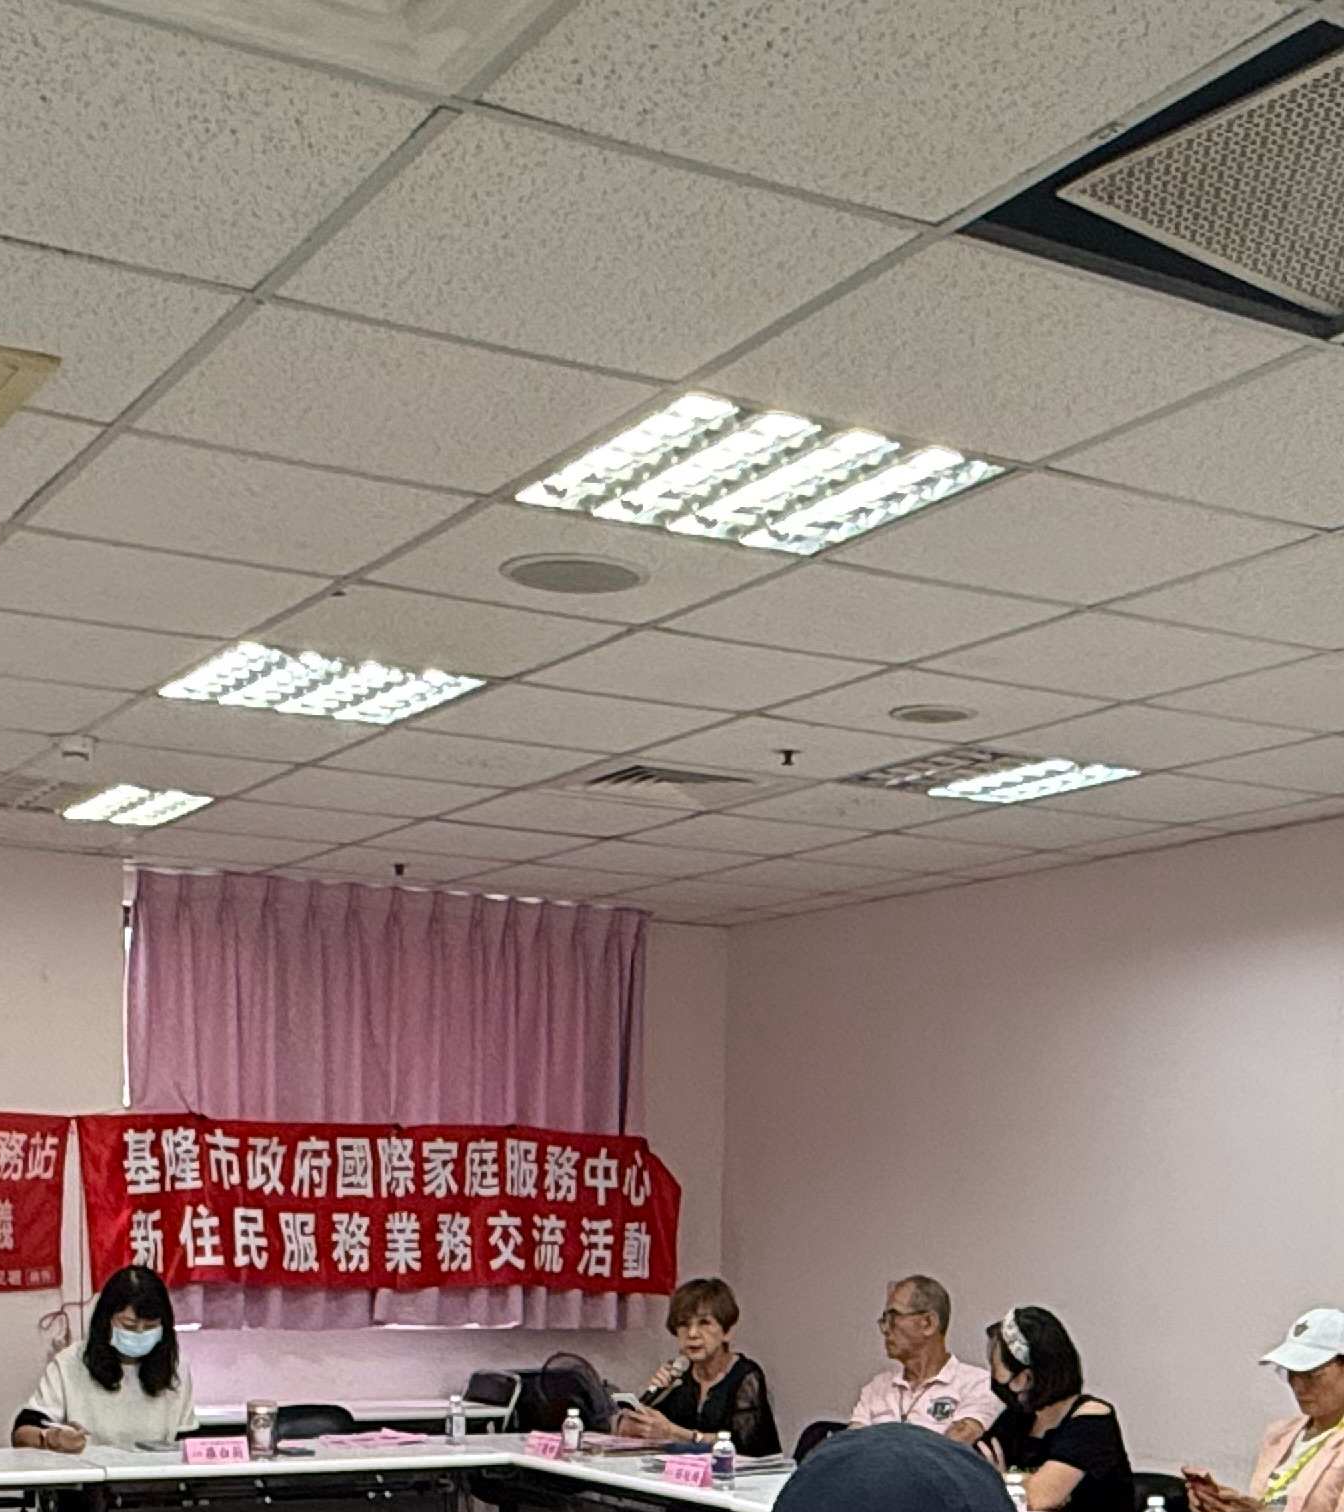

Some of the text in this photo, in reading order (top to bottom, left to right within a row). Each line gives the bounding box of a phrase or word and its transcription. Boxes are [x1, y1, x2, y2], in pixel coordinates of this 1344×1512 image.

[123, 1127, 653, 1206] 基隆市政府國際家庭服務中心
[129, 1203, 653, 1281] 新住民服務業務交流活動
